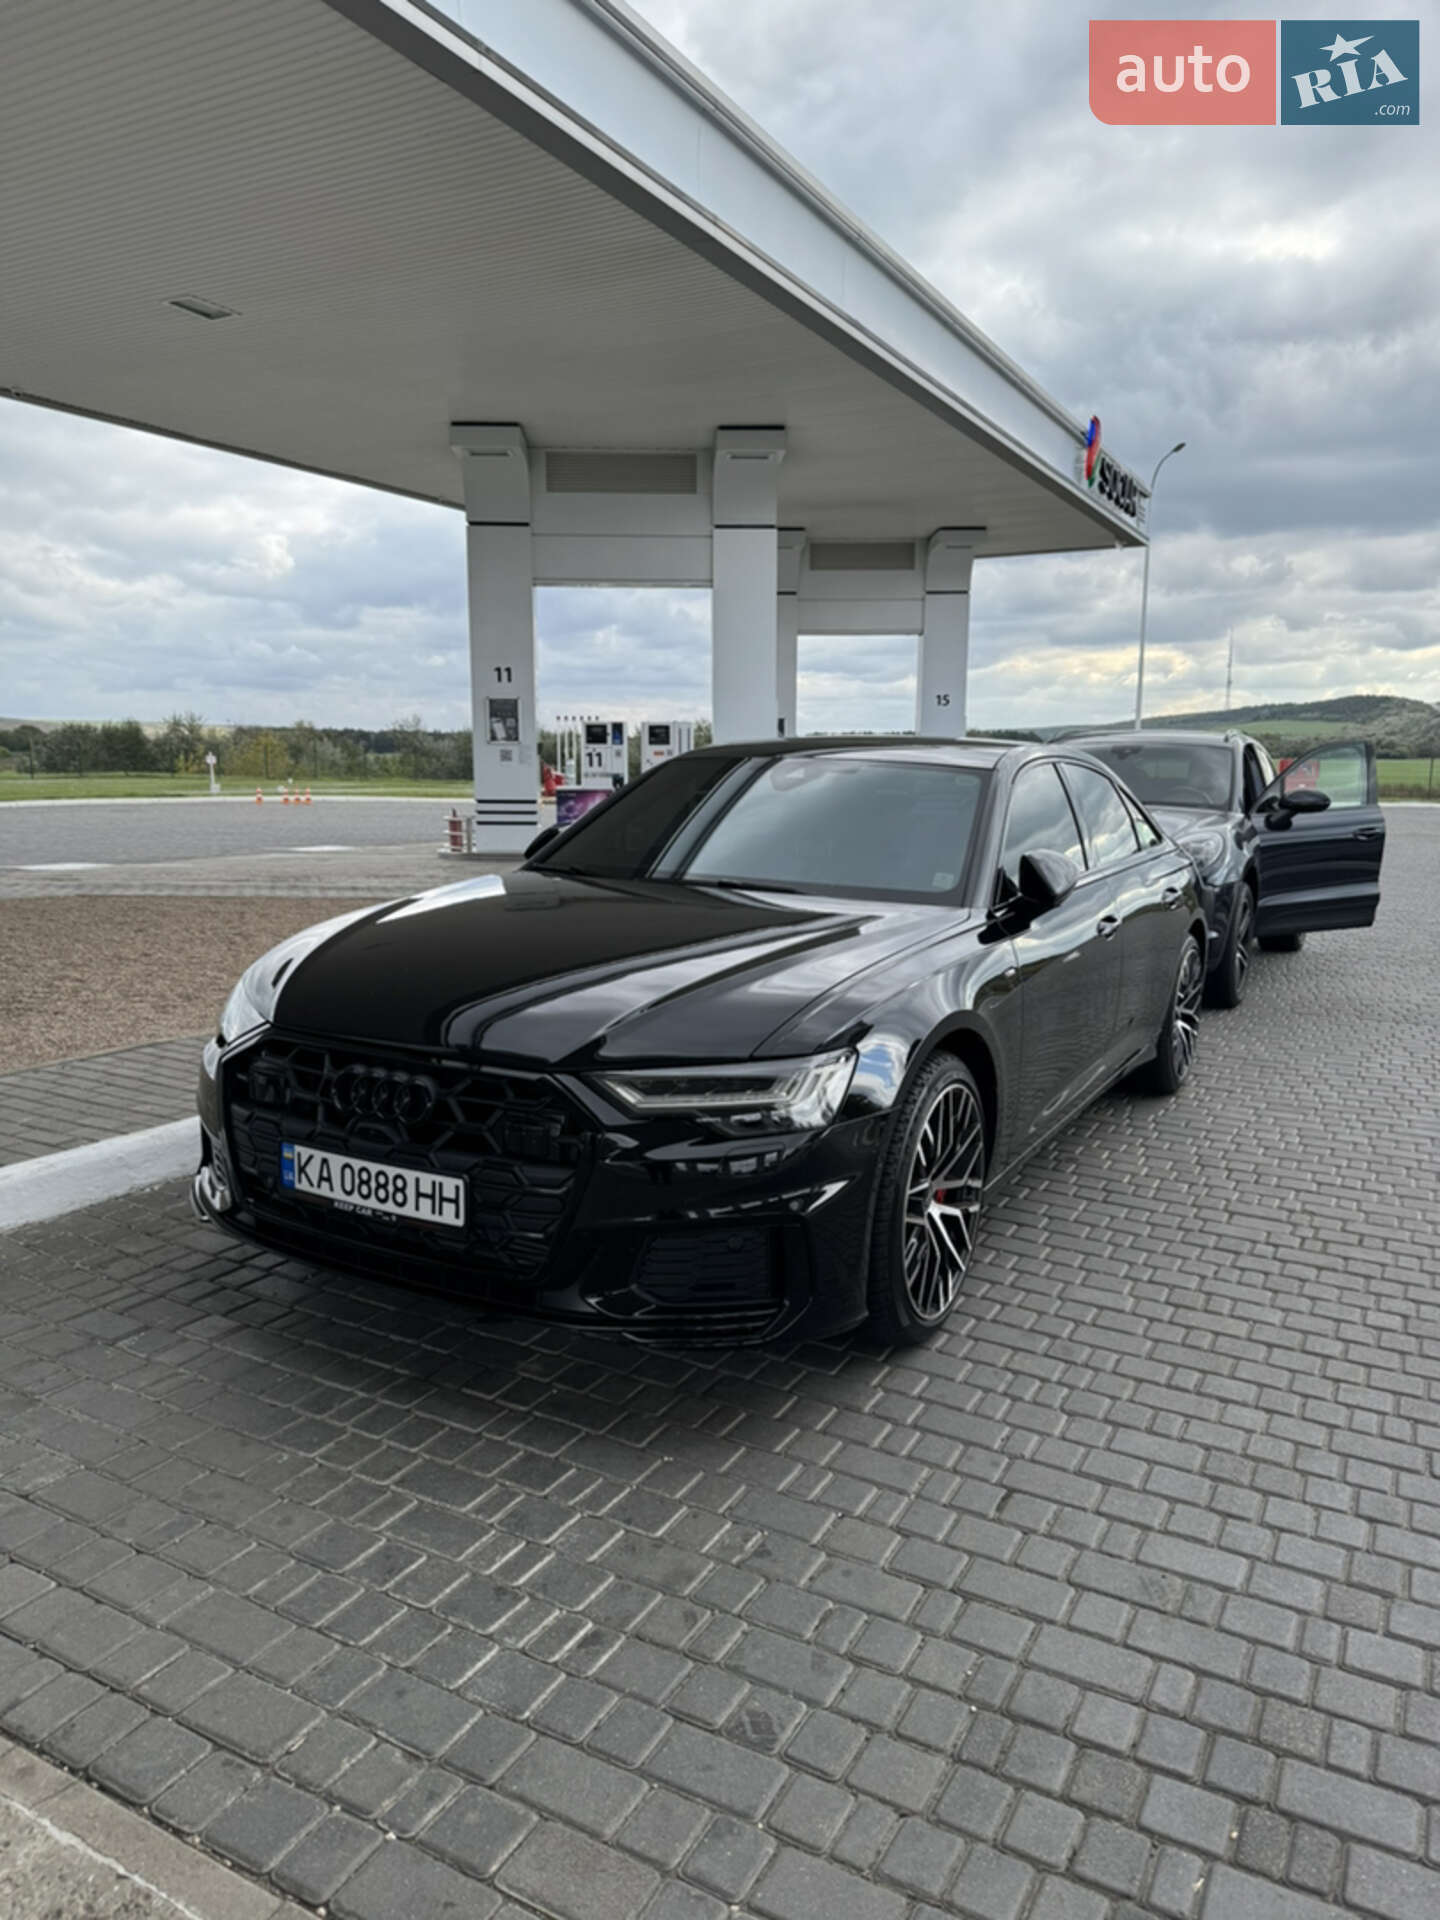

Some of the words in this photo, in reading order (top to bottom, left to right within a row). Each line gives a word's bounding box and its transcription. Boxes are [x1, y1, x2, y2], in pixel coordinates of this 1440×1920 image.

[494, 667, 512, 683] 11
[936, 694, 950, 706] 15
[586, 752, 603, 767] 11
[297, 1151, 334, 1193] KA
[340, 1162, 408, 1209] 0888
[414, 1176, 461, 1220] HH
